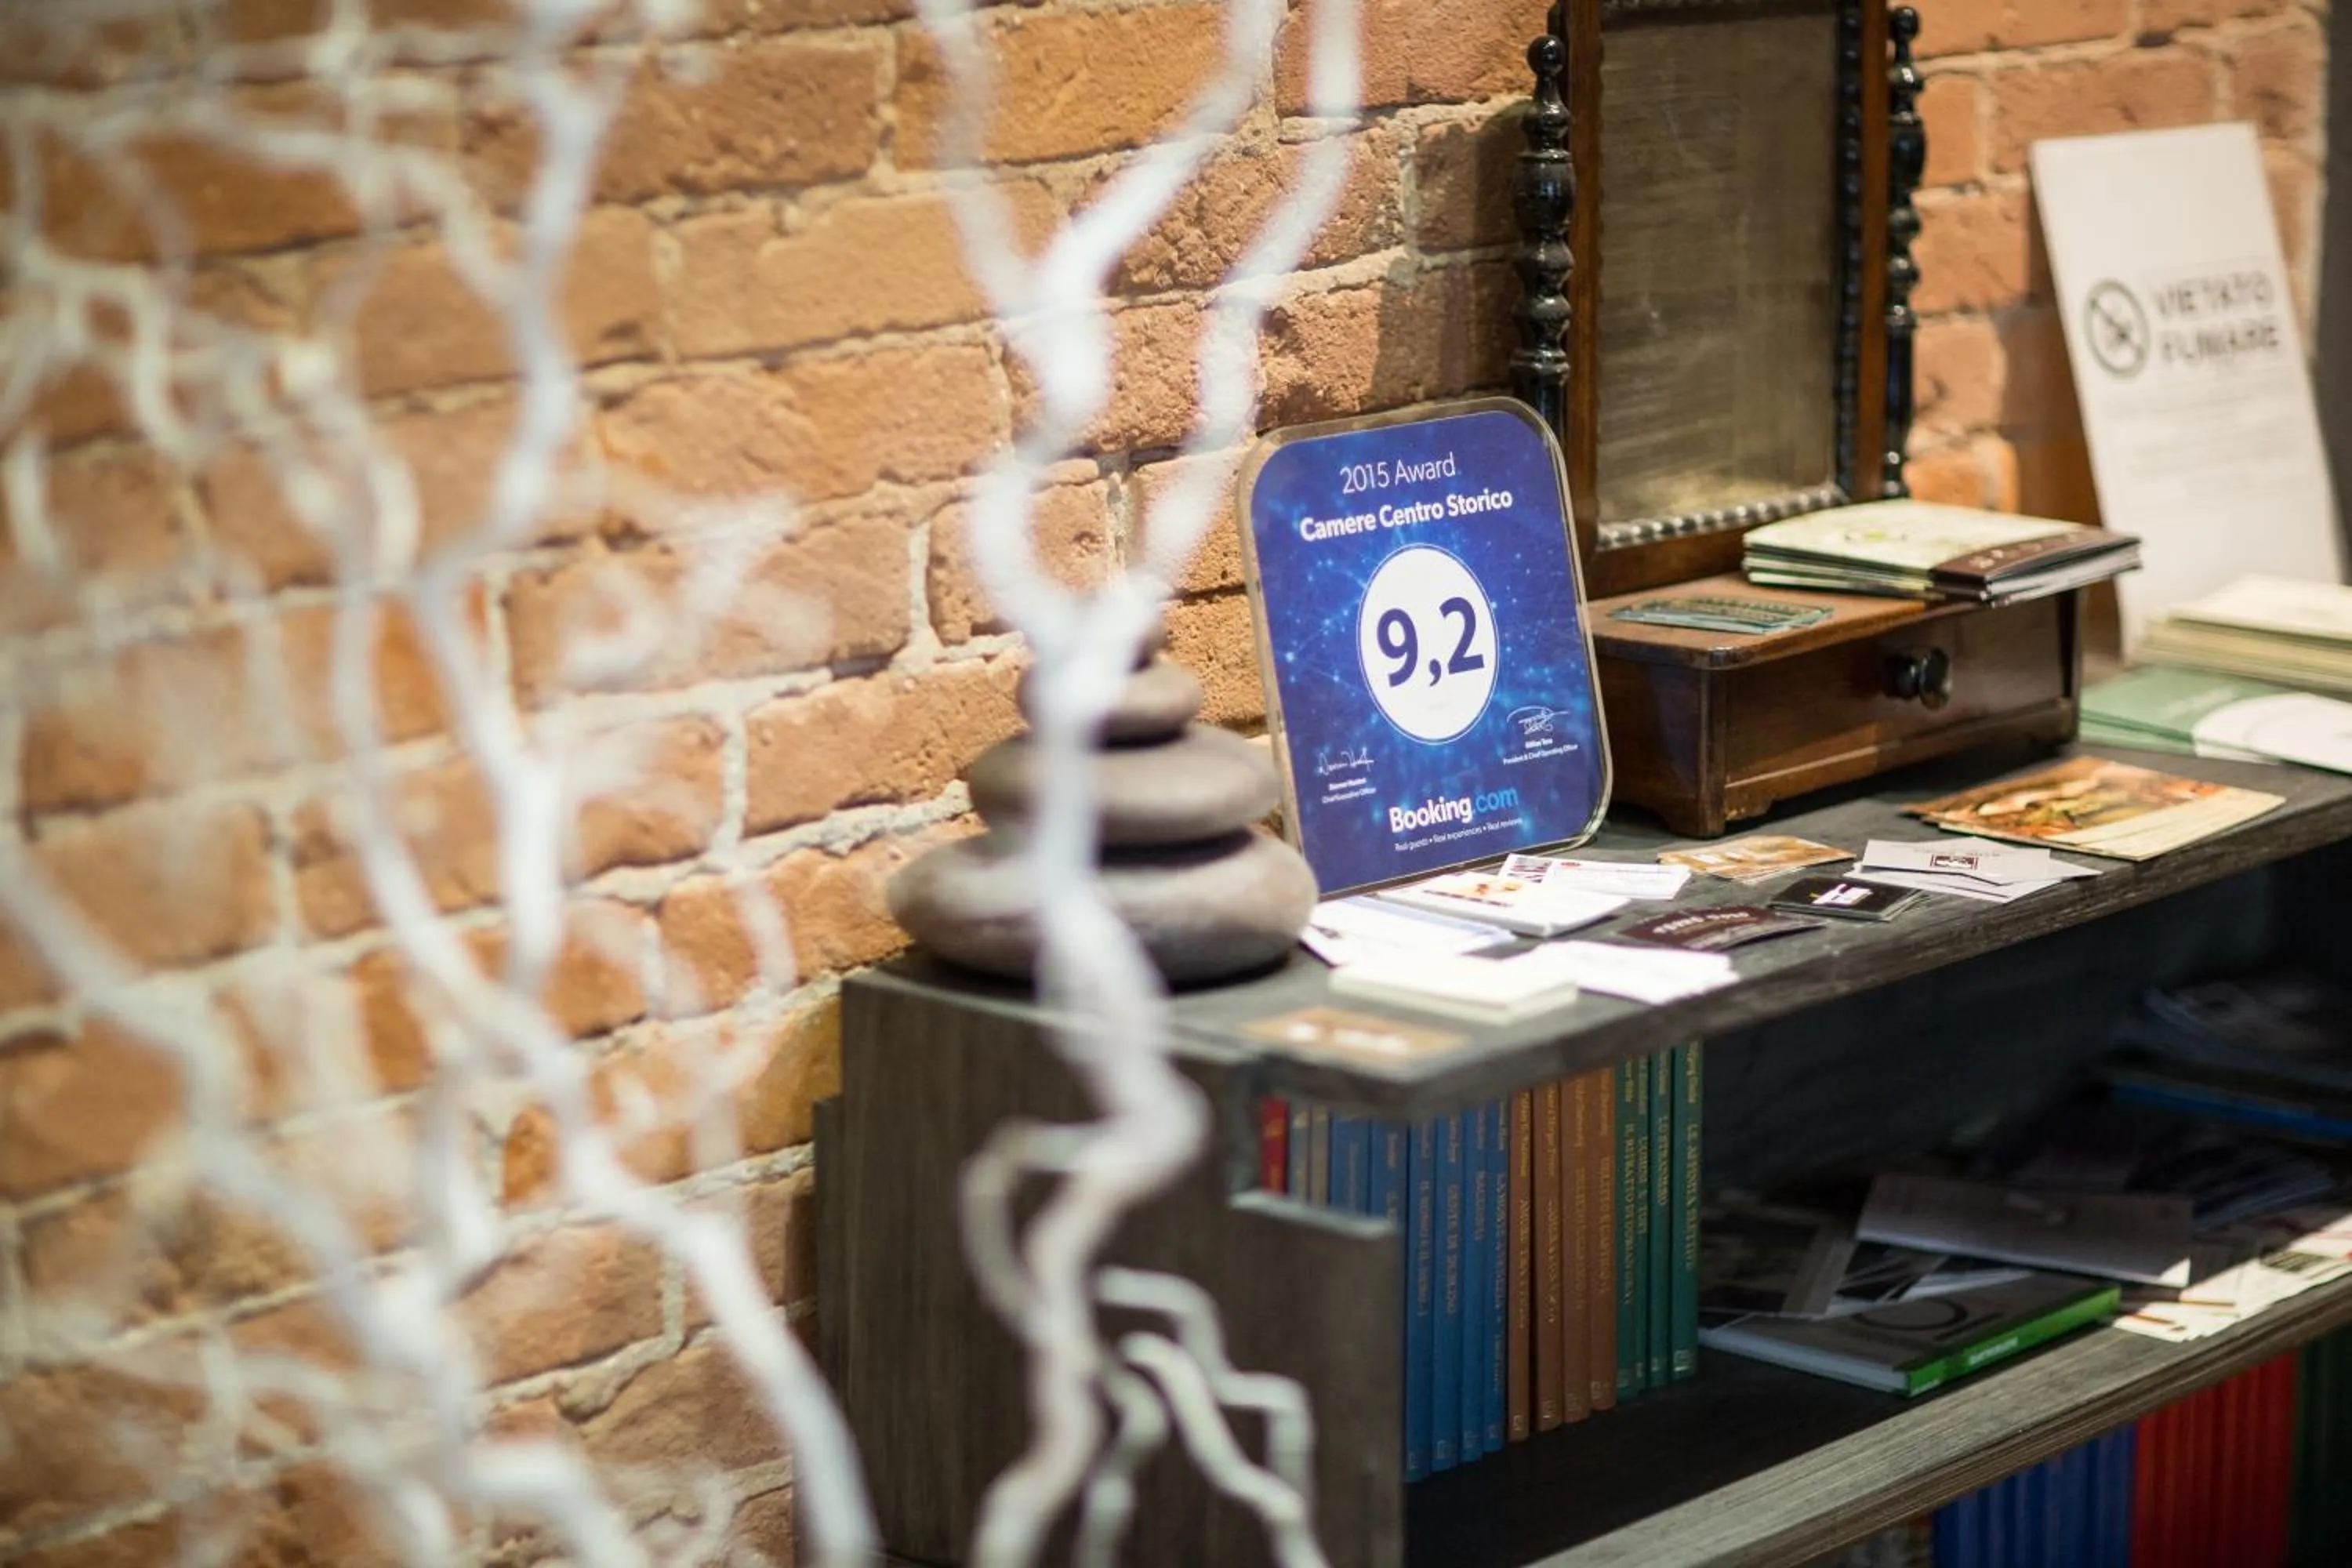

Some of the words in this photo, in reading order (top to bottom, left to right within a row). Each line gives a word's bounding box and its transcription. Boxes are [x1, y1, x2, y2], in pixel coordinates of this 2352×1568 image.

[1339, 461, 1391, 495] 2015
[1394, 451, 1456, 486] Award
[1299, 512, 1377, 543] Camere
[1379, 501, 1445, 528] Centro
[1446, 488, 1514, 517] Storico
[1377, 597, 1484, 688] 9,2
[1388, 786, 1519, 833] Booking.com
